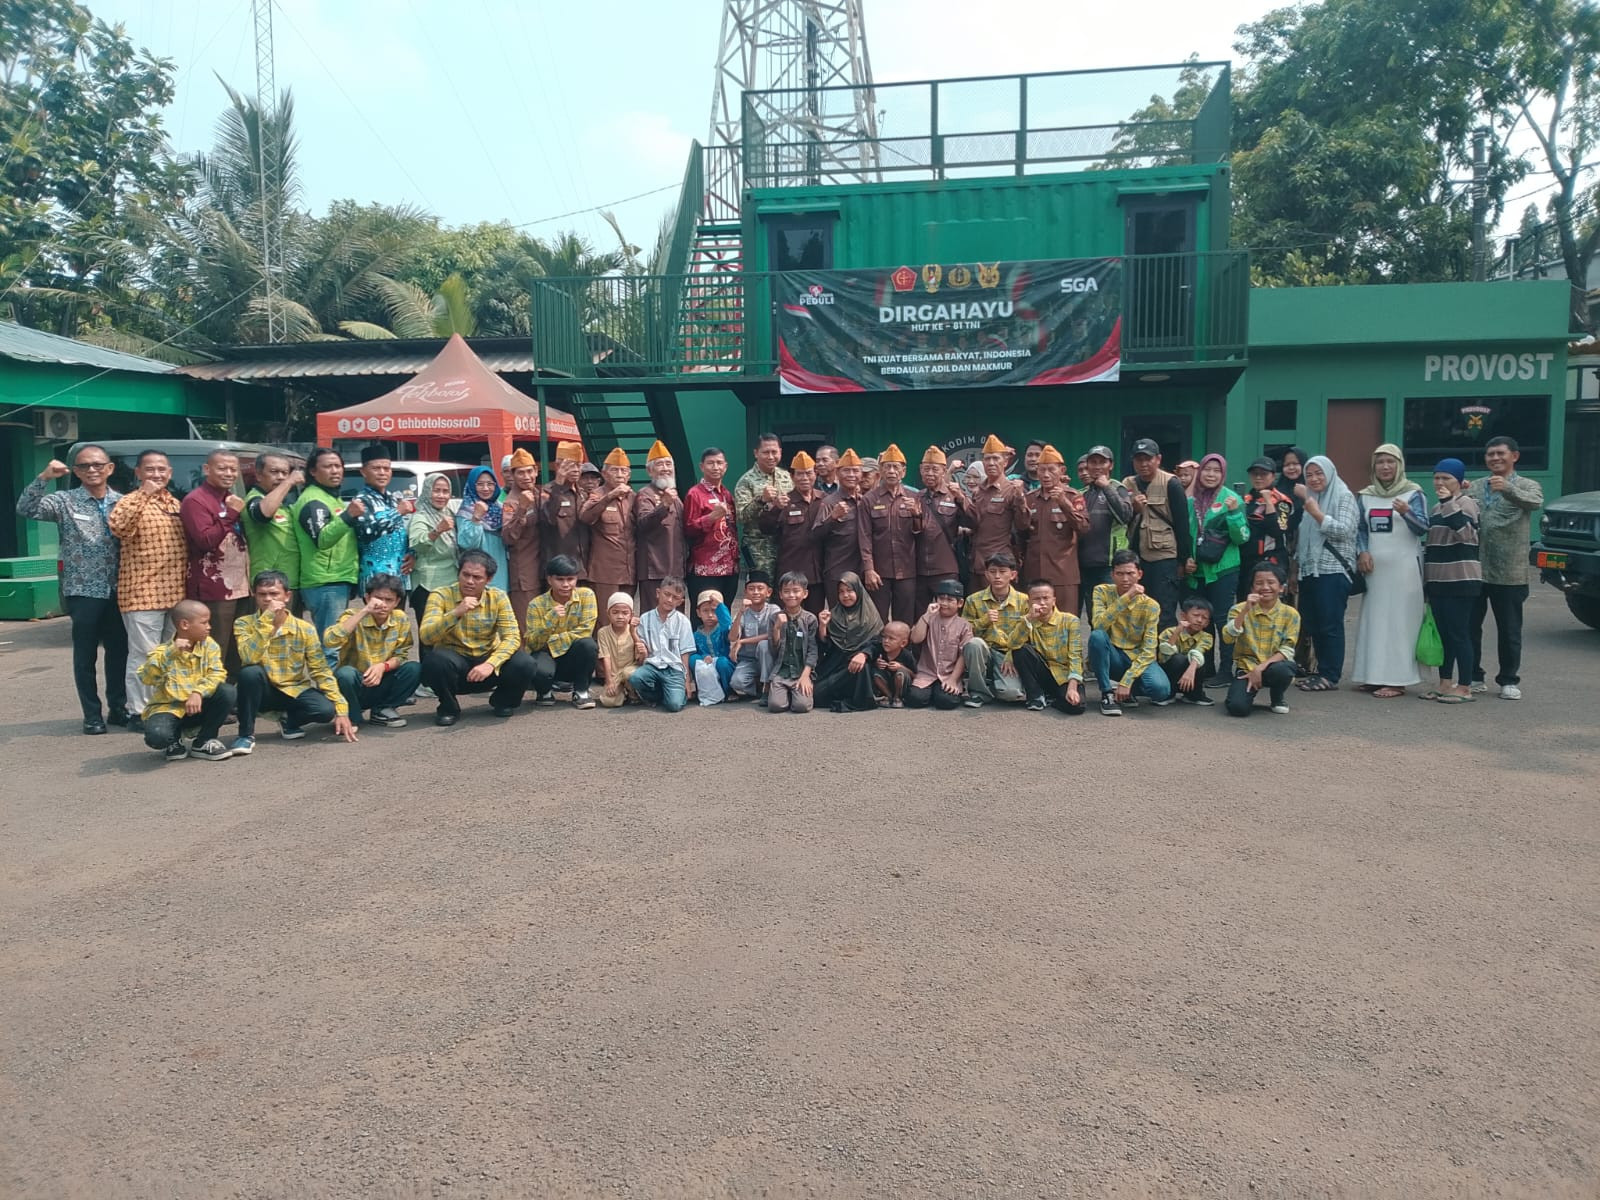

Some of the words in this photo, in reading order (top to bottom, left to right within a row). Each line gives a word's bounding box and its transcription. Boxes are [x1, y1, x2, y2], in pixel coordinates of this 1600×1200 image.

[1061, 277, 1098, 293] SGA
[800, 297, 834, 305] PEDULI
[879, 301, 1014, 323] DIRGAHAYU
[911, 323, 930, 332] HUT
[931, 322, 944, 331] KE
[964, 320, 980, 329] TNI
[862, 356, 877, 364] TNI
[878, 355, 902, 363] KUAT
[902, 353, 944, 362] BERSAMA
[944, 351, 982, 361] RAKYAT,
[983, 349, 1031, 359] INDONESIA
[881, 365, 931, 375] BERDAULAT
[931, 365, 950, 373] ADIL
[951, 364, 971, 372] DAN
[972, 362, 1013, 372] MAKMUR
[1424, 353, 1554, 381] PROVOST
[941, 435, 975, 453] KODIM
